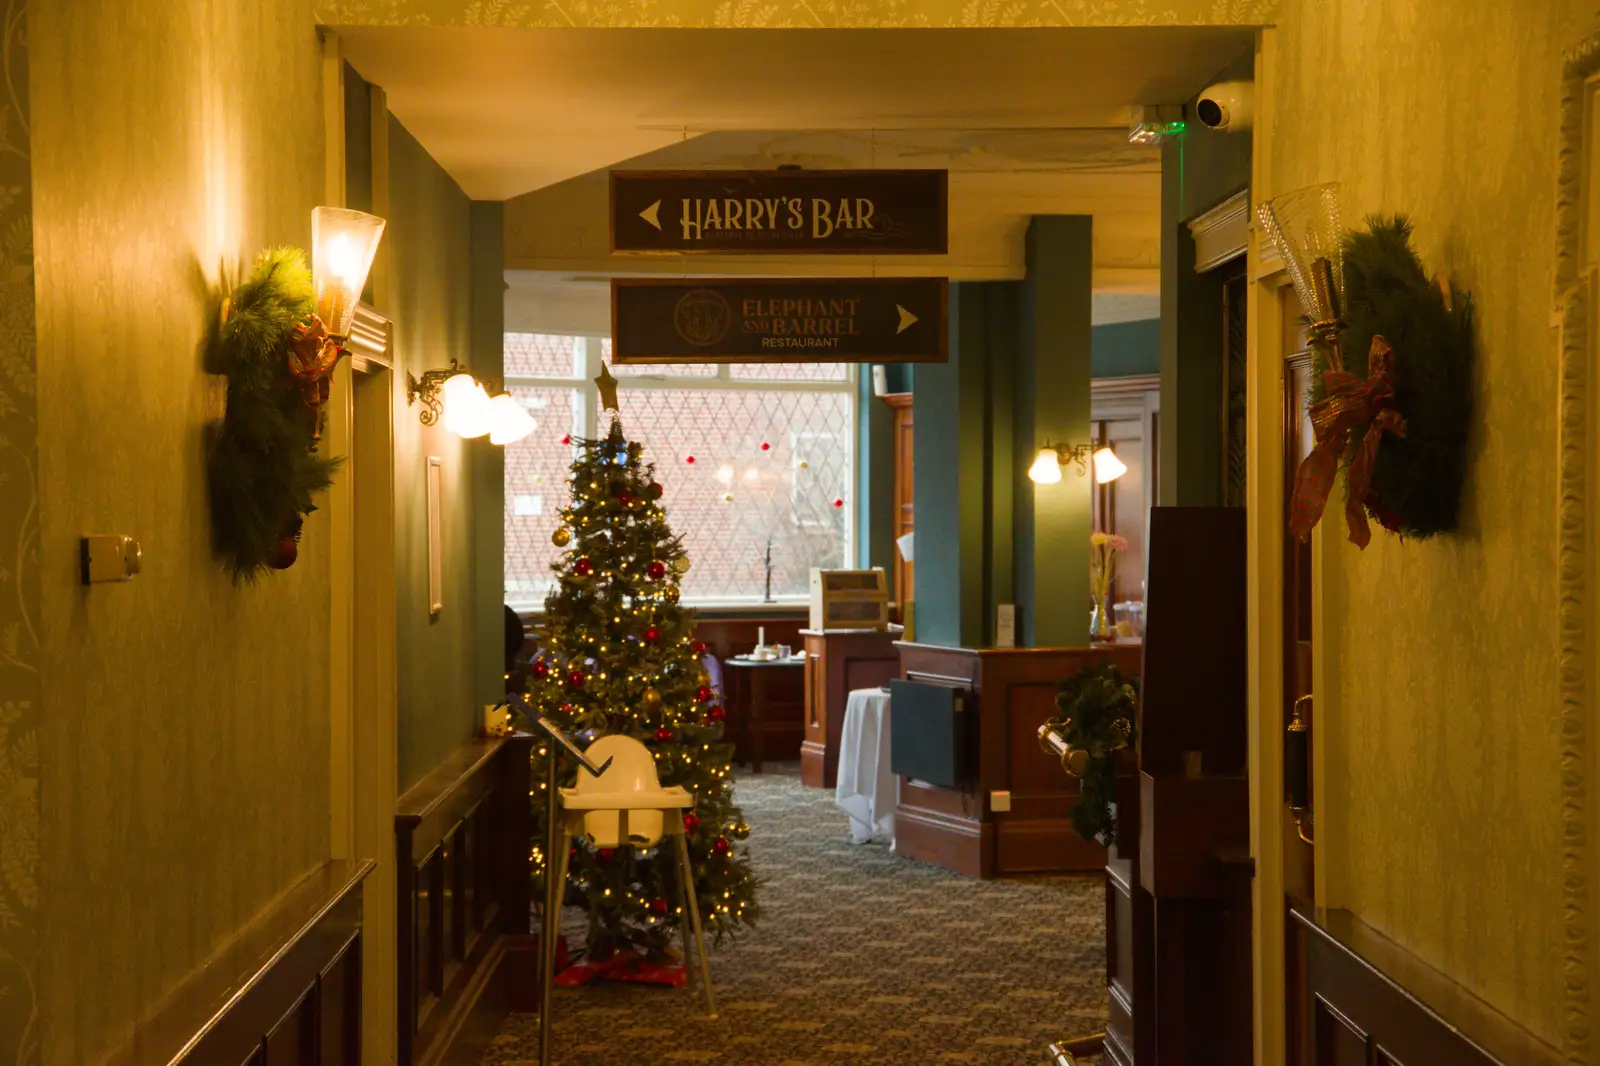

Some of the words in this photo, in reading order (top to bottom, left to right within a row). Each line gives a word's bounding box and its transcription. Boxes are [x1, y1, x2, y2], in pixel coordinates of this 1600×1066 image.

[680, 197, 804, 240] HARRY'S
[811, 198, 875, 239] BAR
[742, 298, 860, 317] ELEPHANT
[743, 319, 770, 331] AND
[772, 317, 860, 335] BARREL
[762, 337, 840, 348] RESTAURANT
